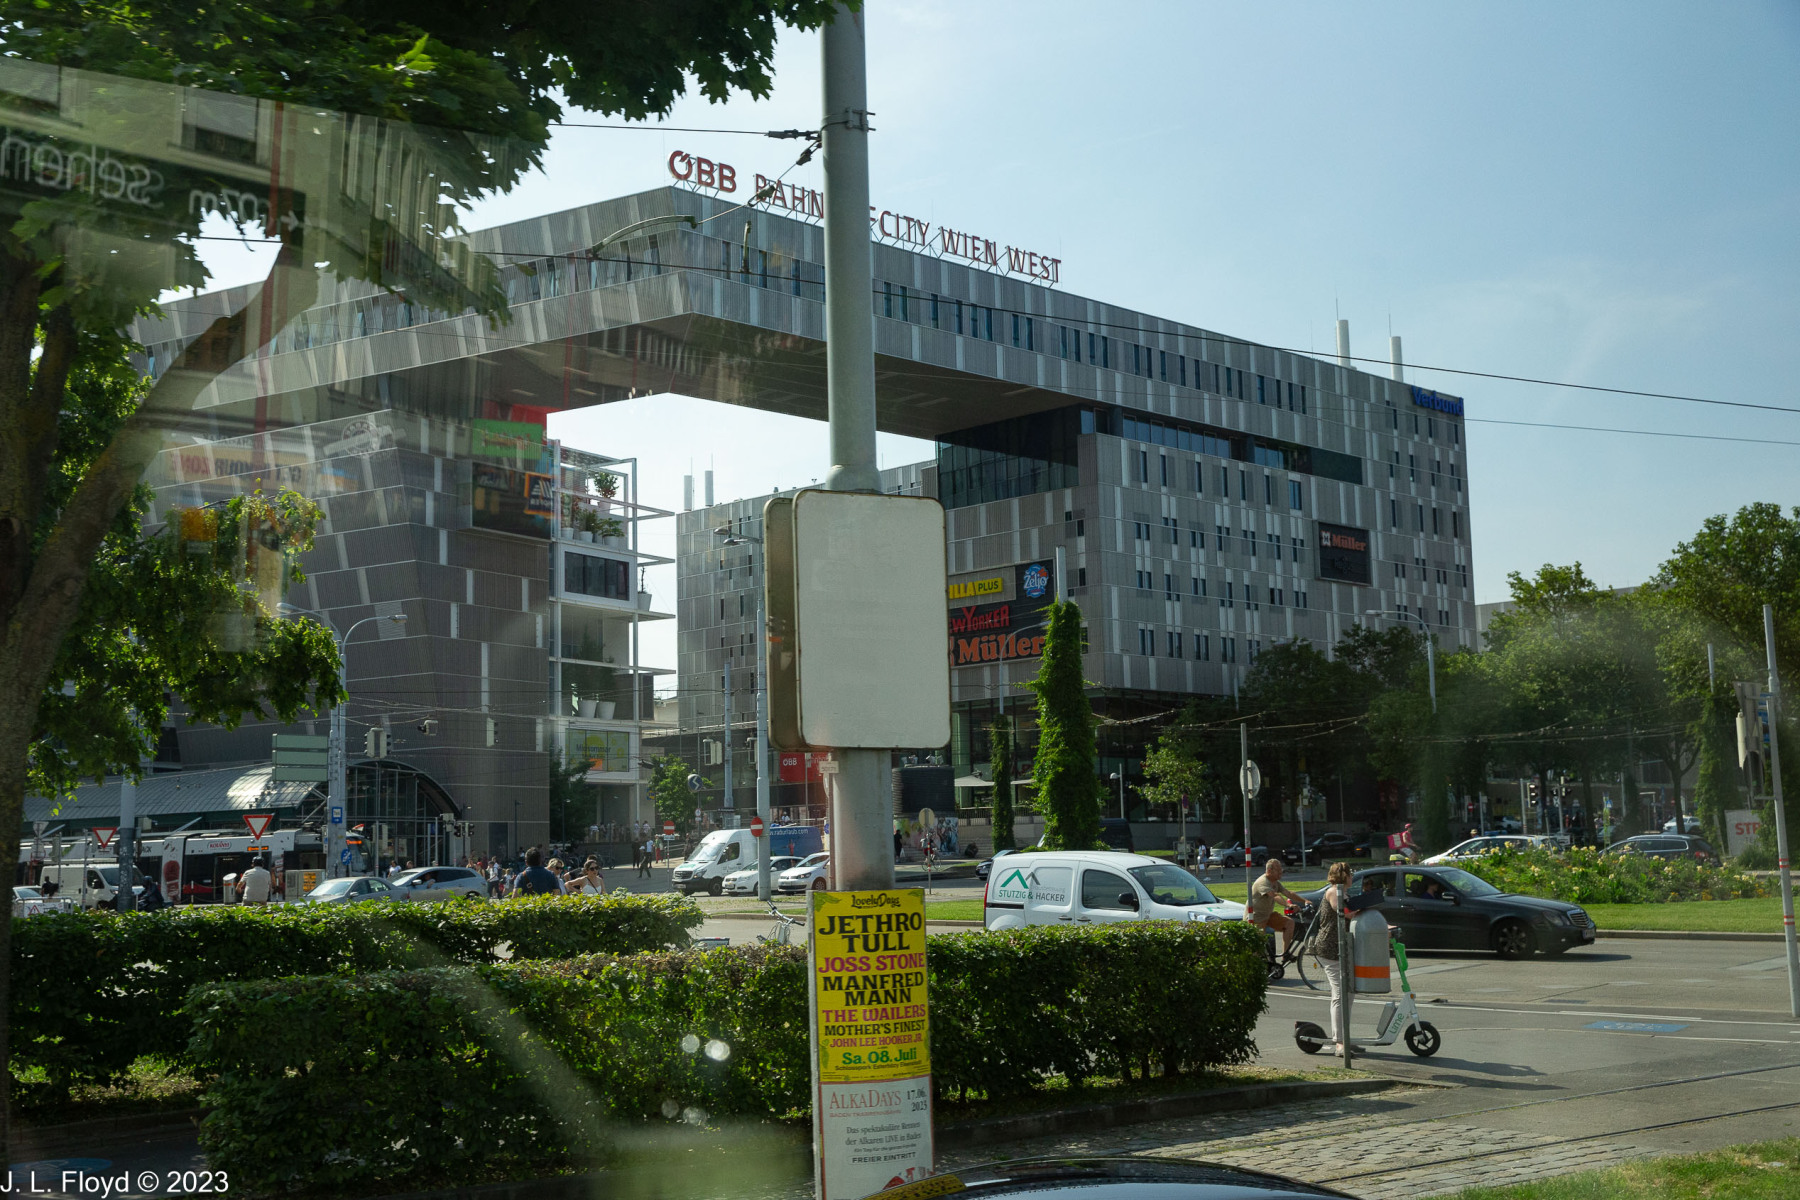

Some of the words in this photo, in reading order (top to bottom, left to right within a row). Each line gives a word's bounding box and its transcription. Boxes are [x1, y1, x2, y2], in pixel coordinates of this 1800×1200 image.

[938, 226, 997, 266] WIEN
[1005, 245, 1062, 283] WEST
[1411, 385, 1465, 417] Verbund
[1332, 534, 1367, 551] Müller
[949, 582, 976, 599] ILLA
[978, 580, 999, 592] PLUS
[958, 634, 1046, 663] Müller
[998, 889, 1026, 899] STUTZIG
[1027, 891, 1034, 900] &
[1035, 892, 1065, 903] HACKER
[818, 912, 922, 935] JETHRO
[842, 932, 910, 953] TULL
[818, 956, 871, 973] JOSS
[875, 953, 925, 971] STONE
[823, 972, 924, 991] MANFRED
[845, 988, 911, 1006] MANN
[822, 1009, 859, 1022] THE
[862, 1004, 926, 1021] WAILERS
[893, 1019, 925, 1033] FINEST
[1389, 1013, 1405, 1034] Lime
[829, 1037, 857, 1048] JOHN
[860, 1036, 877, 1046] LEE
[878, 1034, 912, 1046] HOOKER
[842, 1052, 866, 1065] Sa.
[868, 1050, 893, 1064] 08.
[894, 1047, 917, 1062] Juli
[846, 1126, 859, 1134] Das
[845, 1136, 857, 1145] der
[885, 1134, 899, 1142] LIVE
[852, 1155, 882, 1163] FREIER
[884, 1152, 916, 1161] EINTRITT
